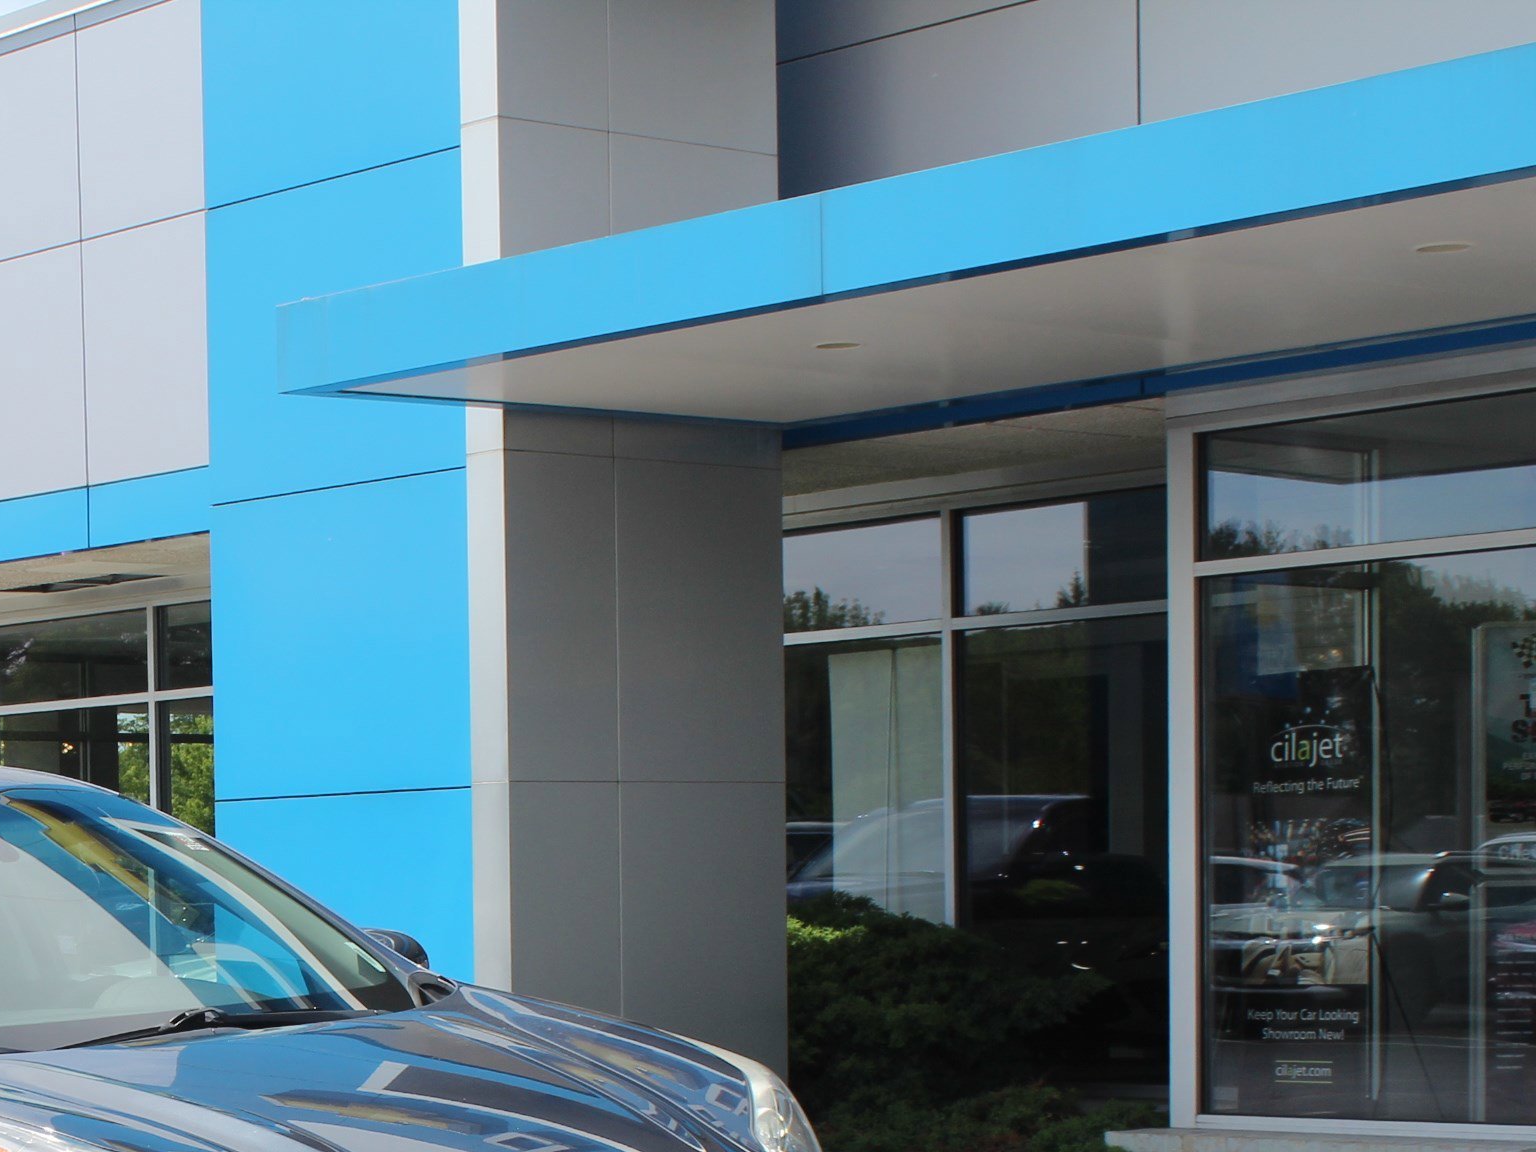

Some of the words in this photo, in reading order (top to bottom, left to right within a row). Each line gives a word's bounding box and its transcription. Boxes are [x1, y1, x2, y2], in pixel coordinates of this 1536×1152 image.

[1270, 732, 1344, 768] cilajet
[1252, 779, 1304, 794] Reflecting
[1307, 778, 1324, 791] the
[1247, 1009, 1274, 1022] Keep
[1276, 1009, 1298, 1020] Your
[1300, 1008, 1317, 1020] Car
[1319, 1009, 1359, 1023] Looking
[1262, 1028, 1316, 1040] Showroom
[1318, 1029, 1345, 1040] New!
[1275, 1064, 1331, 1079] cilajet.com
